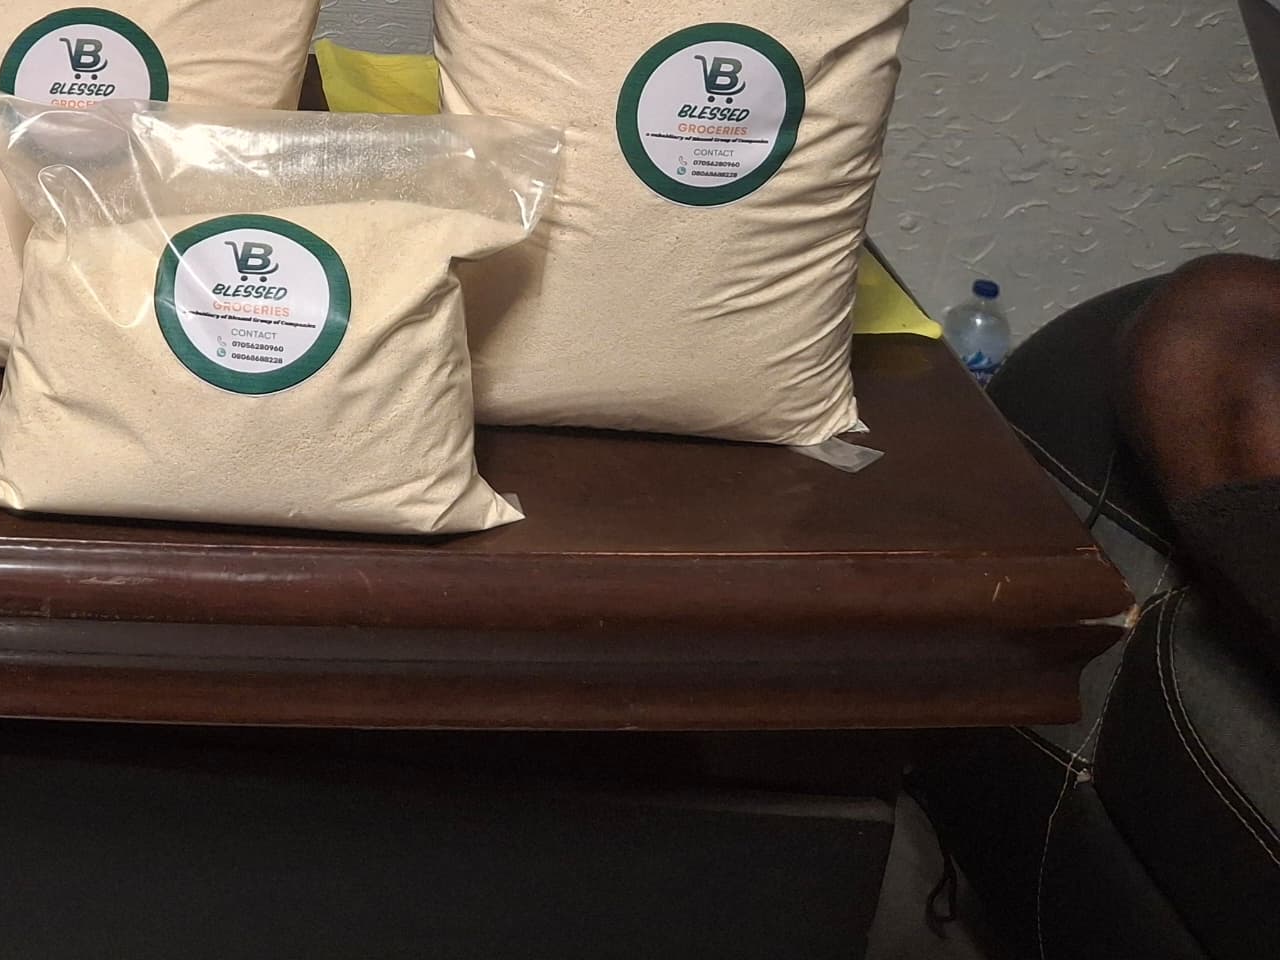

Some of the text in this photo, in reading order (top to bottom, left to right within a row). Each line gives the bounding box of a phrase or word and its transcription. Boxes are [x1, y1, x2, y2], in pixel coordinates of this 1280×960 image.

[49, 82, 115, 97] BLESSED
[677, 104, 750, 122] BLESSED
[677, 123, 748, 136] GROCERIES
[693, 148, 734, 157] CONTACT
[212, 283, 288, 301] BLESSED
[212, 300, 290, 317] GROCERIES
[231, 328, 278, 339] CONTACT
[231, 340, 284, 352] 07056280960
[231, 352, 283, 364] 08068688228
